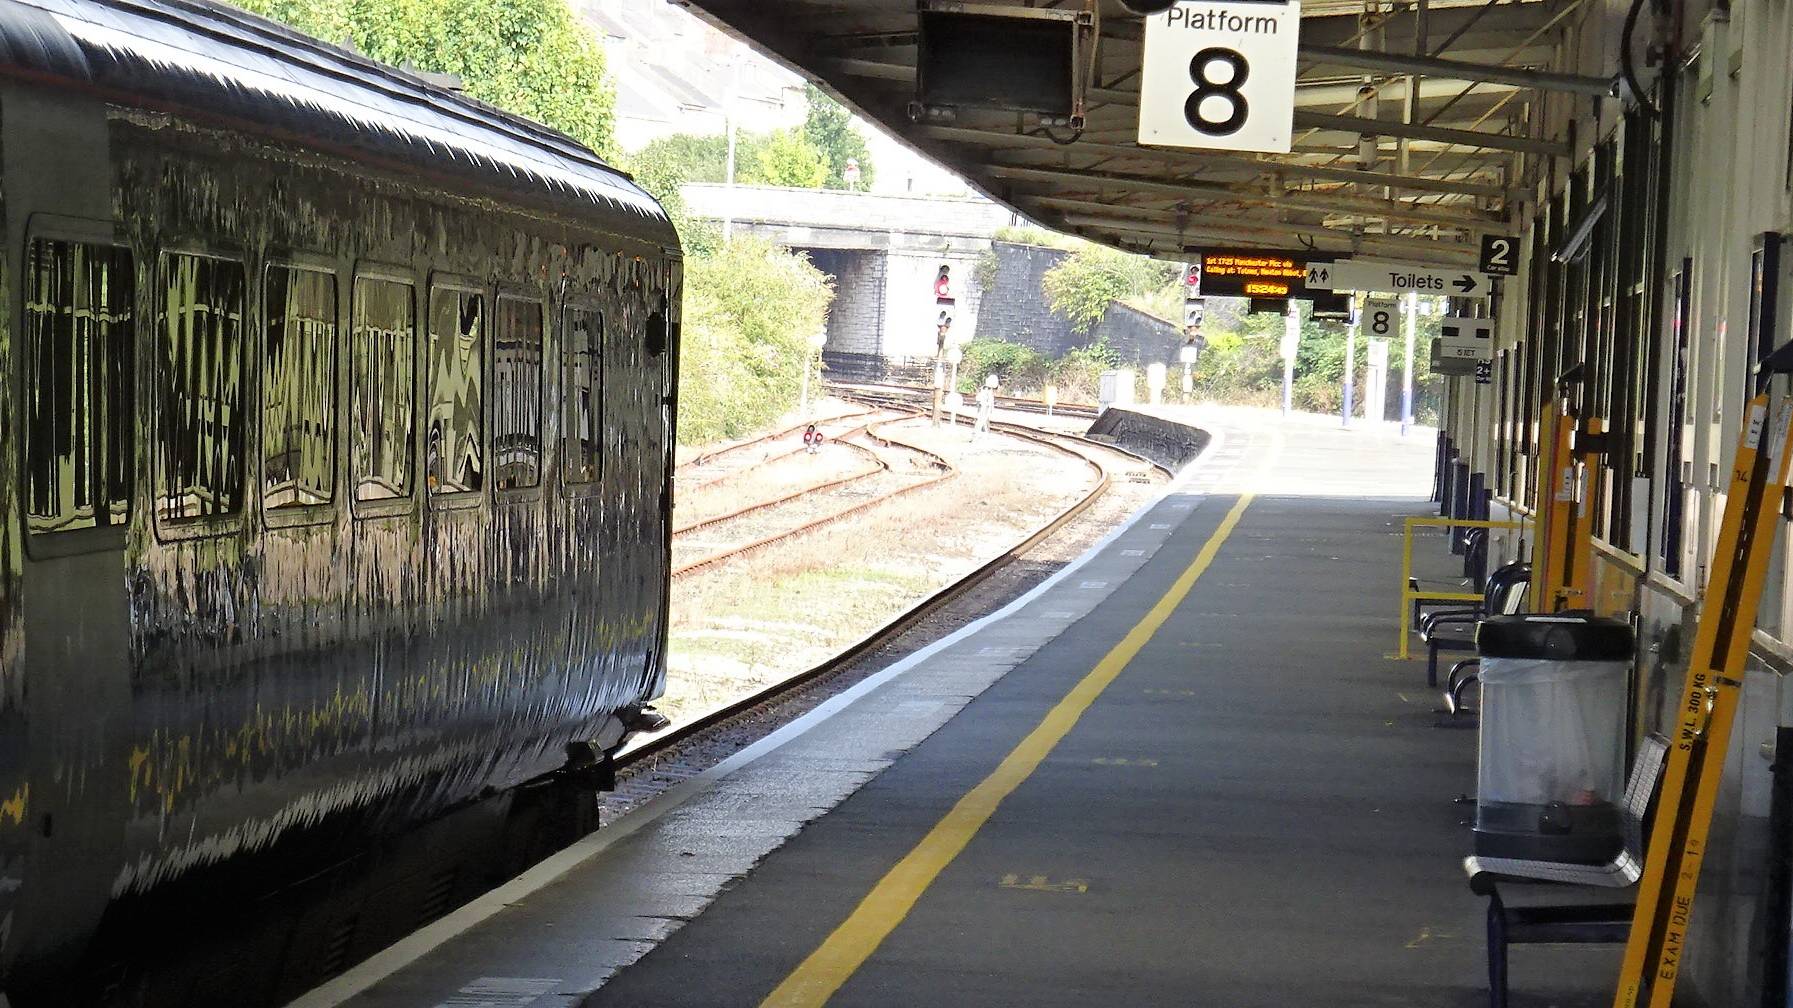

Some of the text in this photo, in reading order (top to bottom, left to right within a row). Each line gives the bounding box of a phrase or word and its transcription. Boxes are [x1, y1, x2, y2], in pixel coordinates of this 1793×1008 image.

[1167, 7, 1278, 34] Platform
[1184, 46, 1250, 137] 8
[1490, 239, 1510, 265] 2
[1388, 272, 1444, 290] Toilets
[1372, 311, 1390, 335] 8
[1688, 691, 1702, 714] 300
[1660, 931, 1681, 980] EXAM
[1673, 895, 1691, 925] DUE
